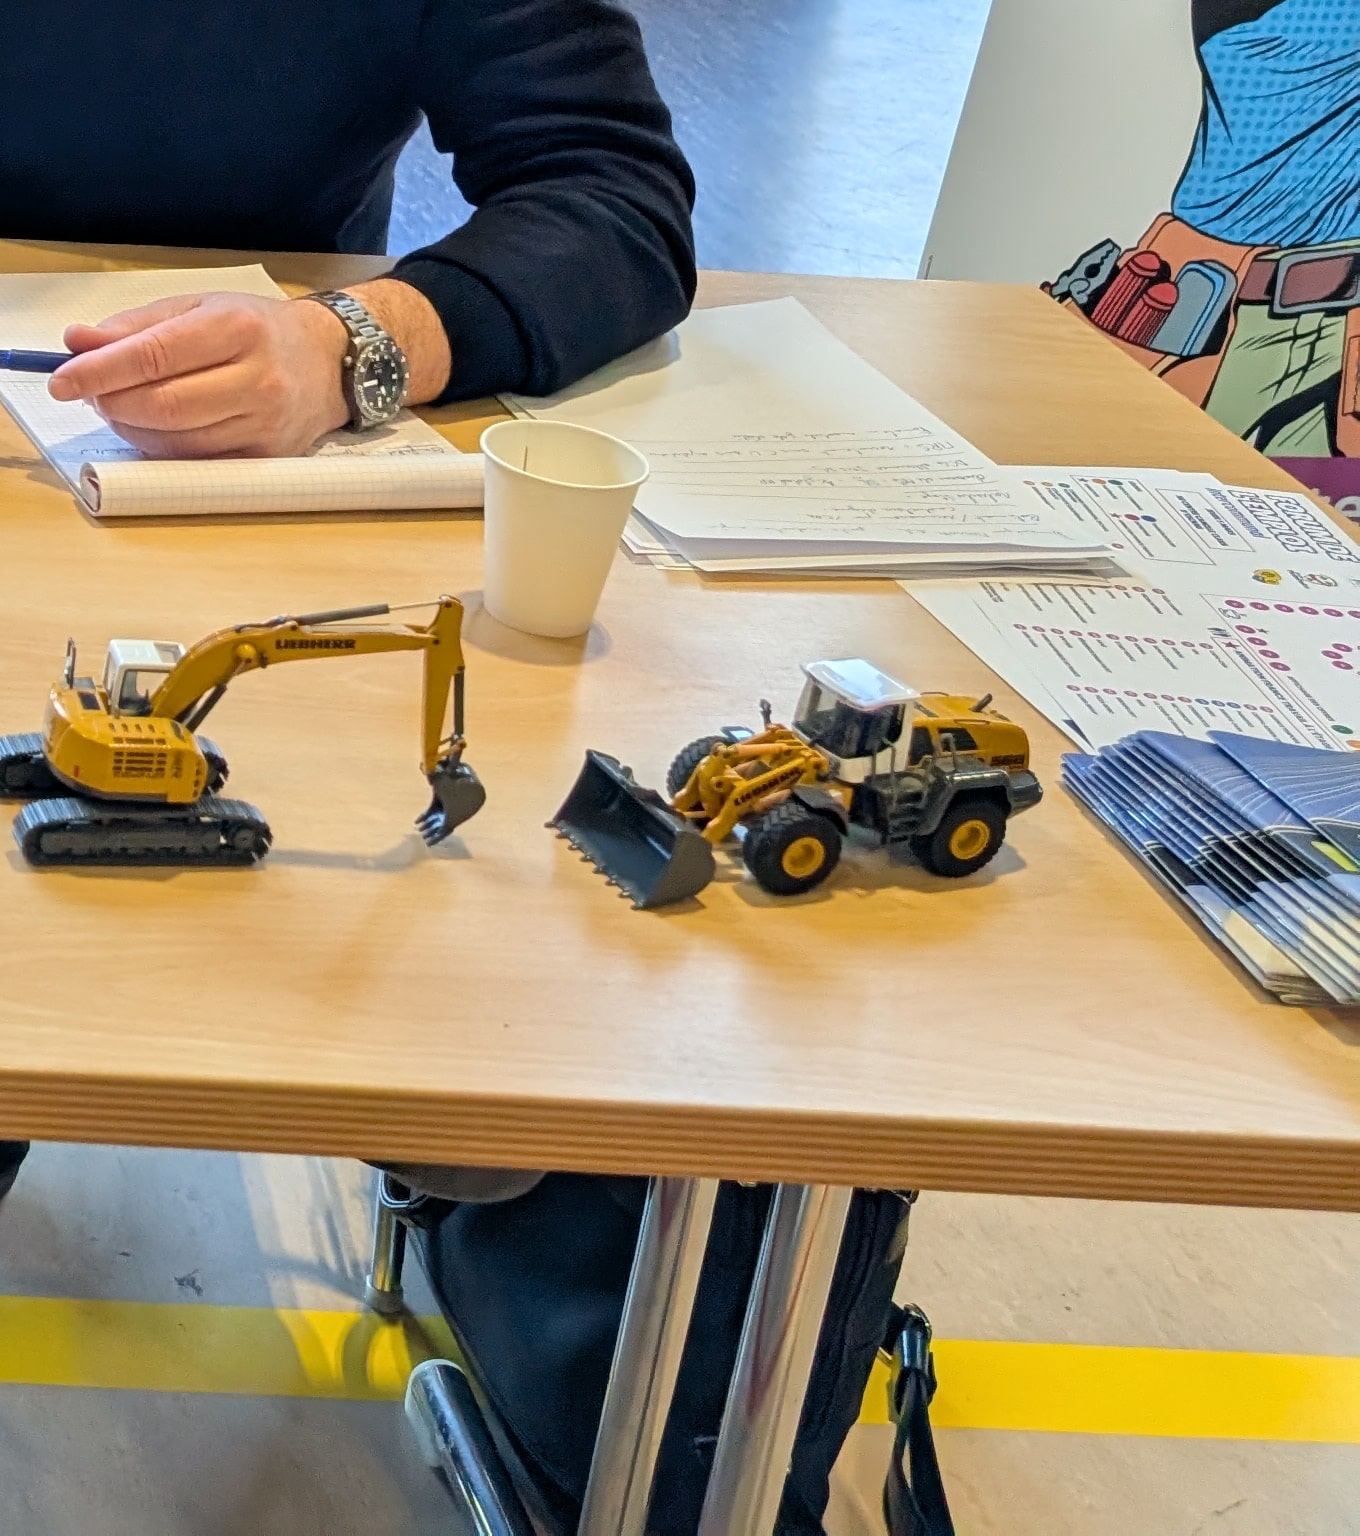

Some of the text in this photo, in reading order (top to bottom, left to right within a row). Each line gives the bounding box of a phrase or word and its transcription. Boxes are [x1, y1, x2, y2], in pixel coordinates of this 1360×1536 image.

[1227, 489, 1319, 554] L'EMPLOI
[1264, 493, 1342, 545] FORUM
[275, 639, 357, 650] LIEBHERR
